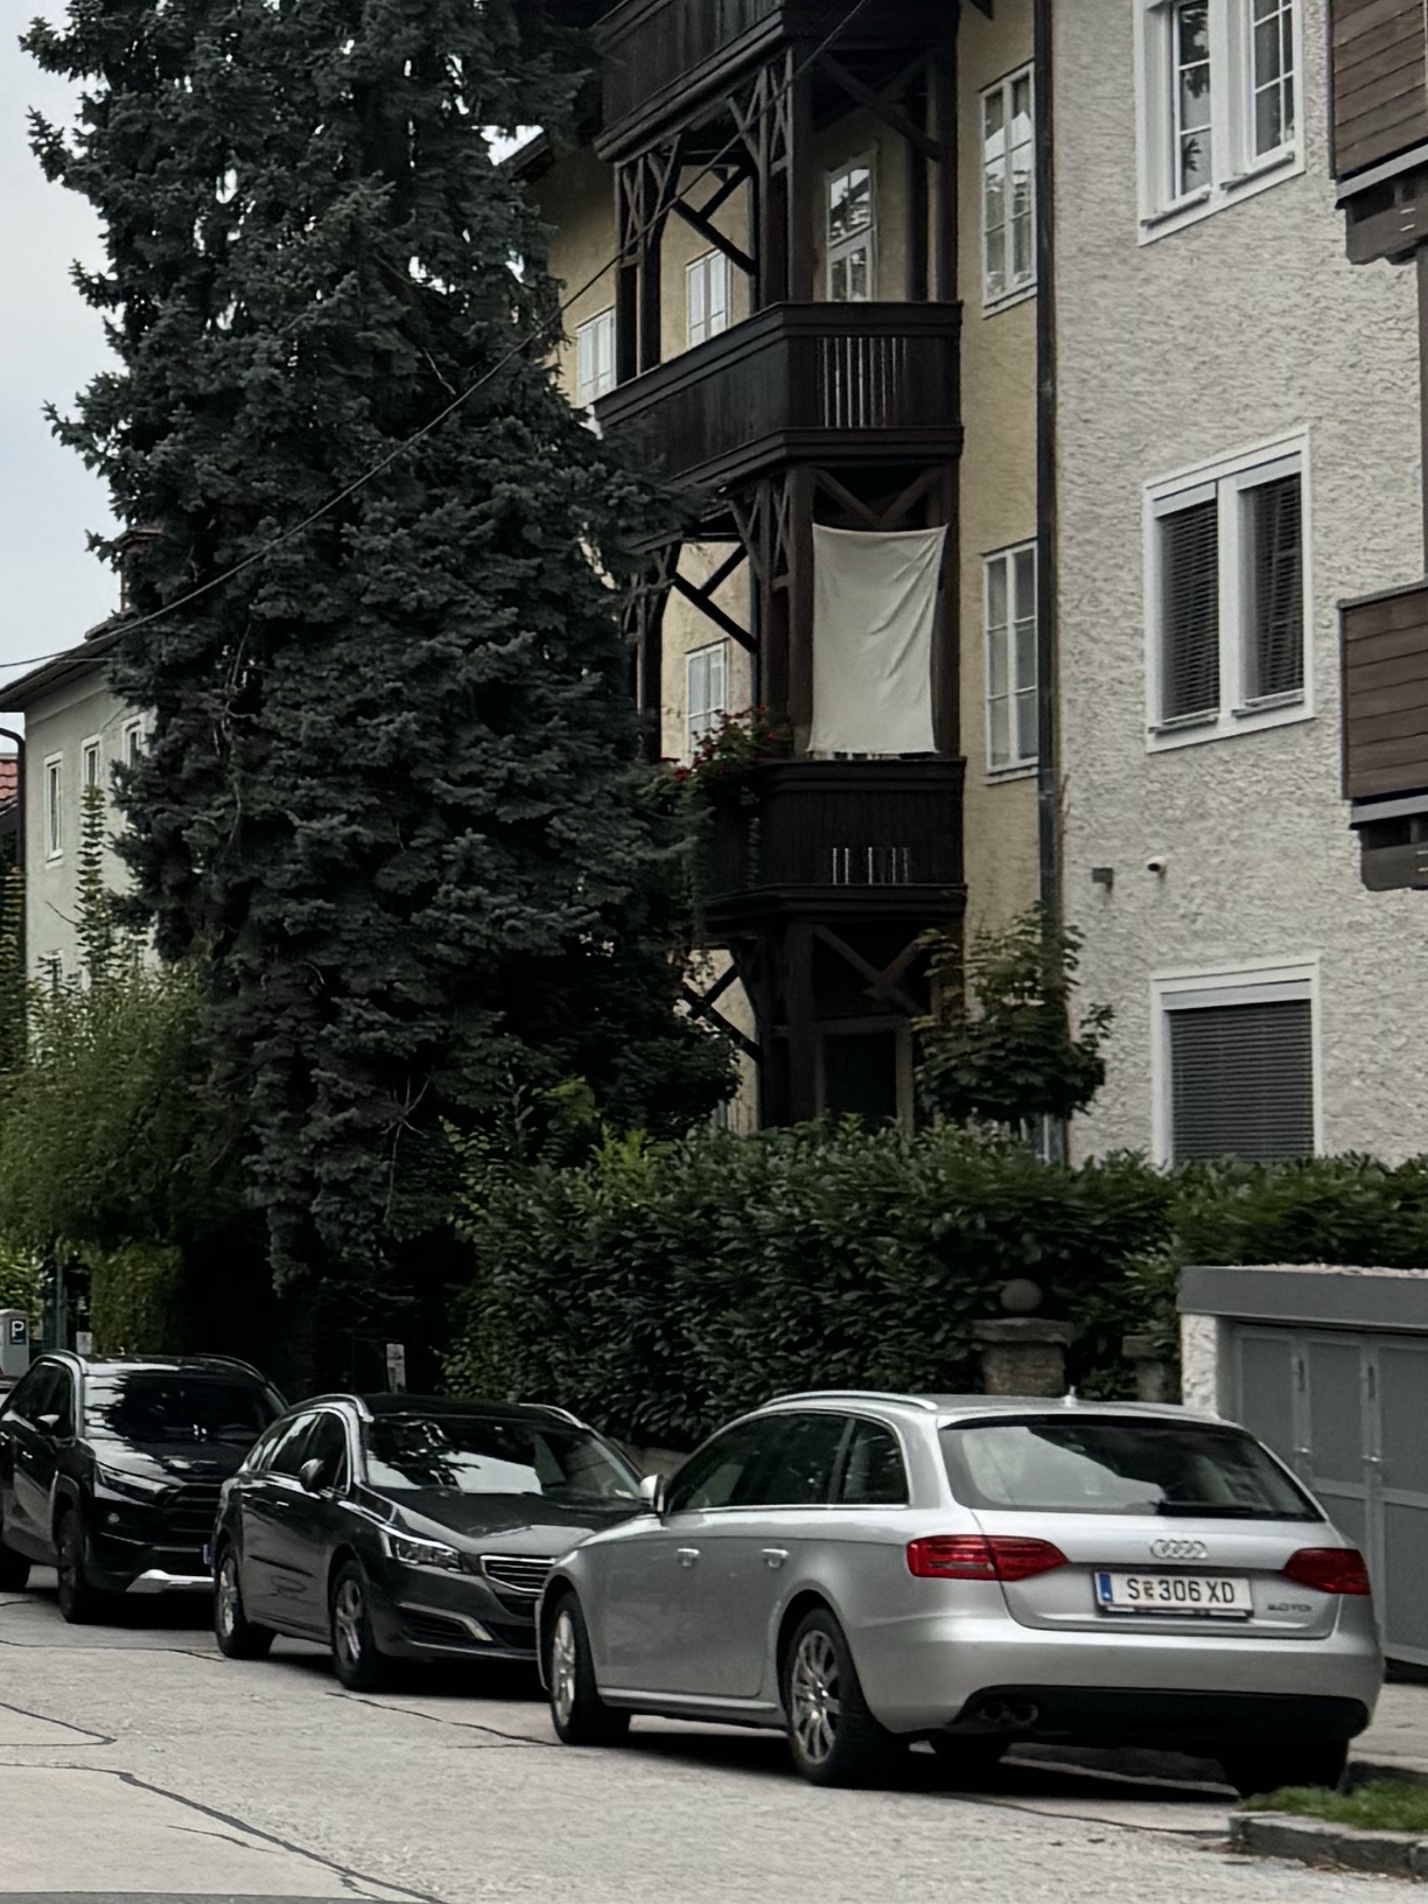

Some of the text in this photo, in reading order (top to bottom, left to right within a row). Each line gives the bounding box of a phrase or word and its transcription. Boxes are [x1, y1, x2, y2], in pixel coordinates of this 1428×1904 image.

[11, 1320, 25, 1338] P
[1127, 1578, 1235, 1604] S 306 XD
